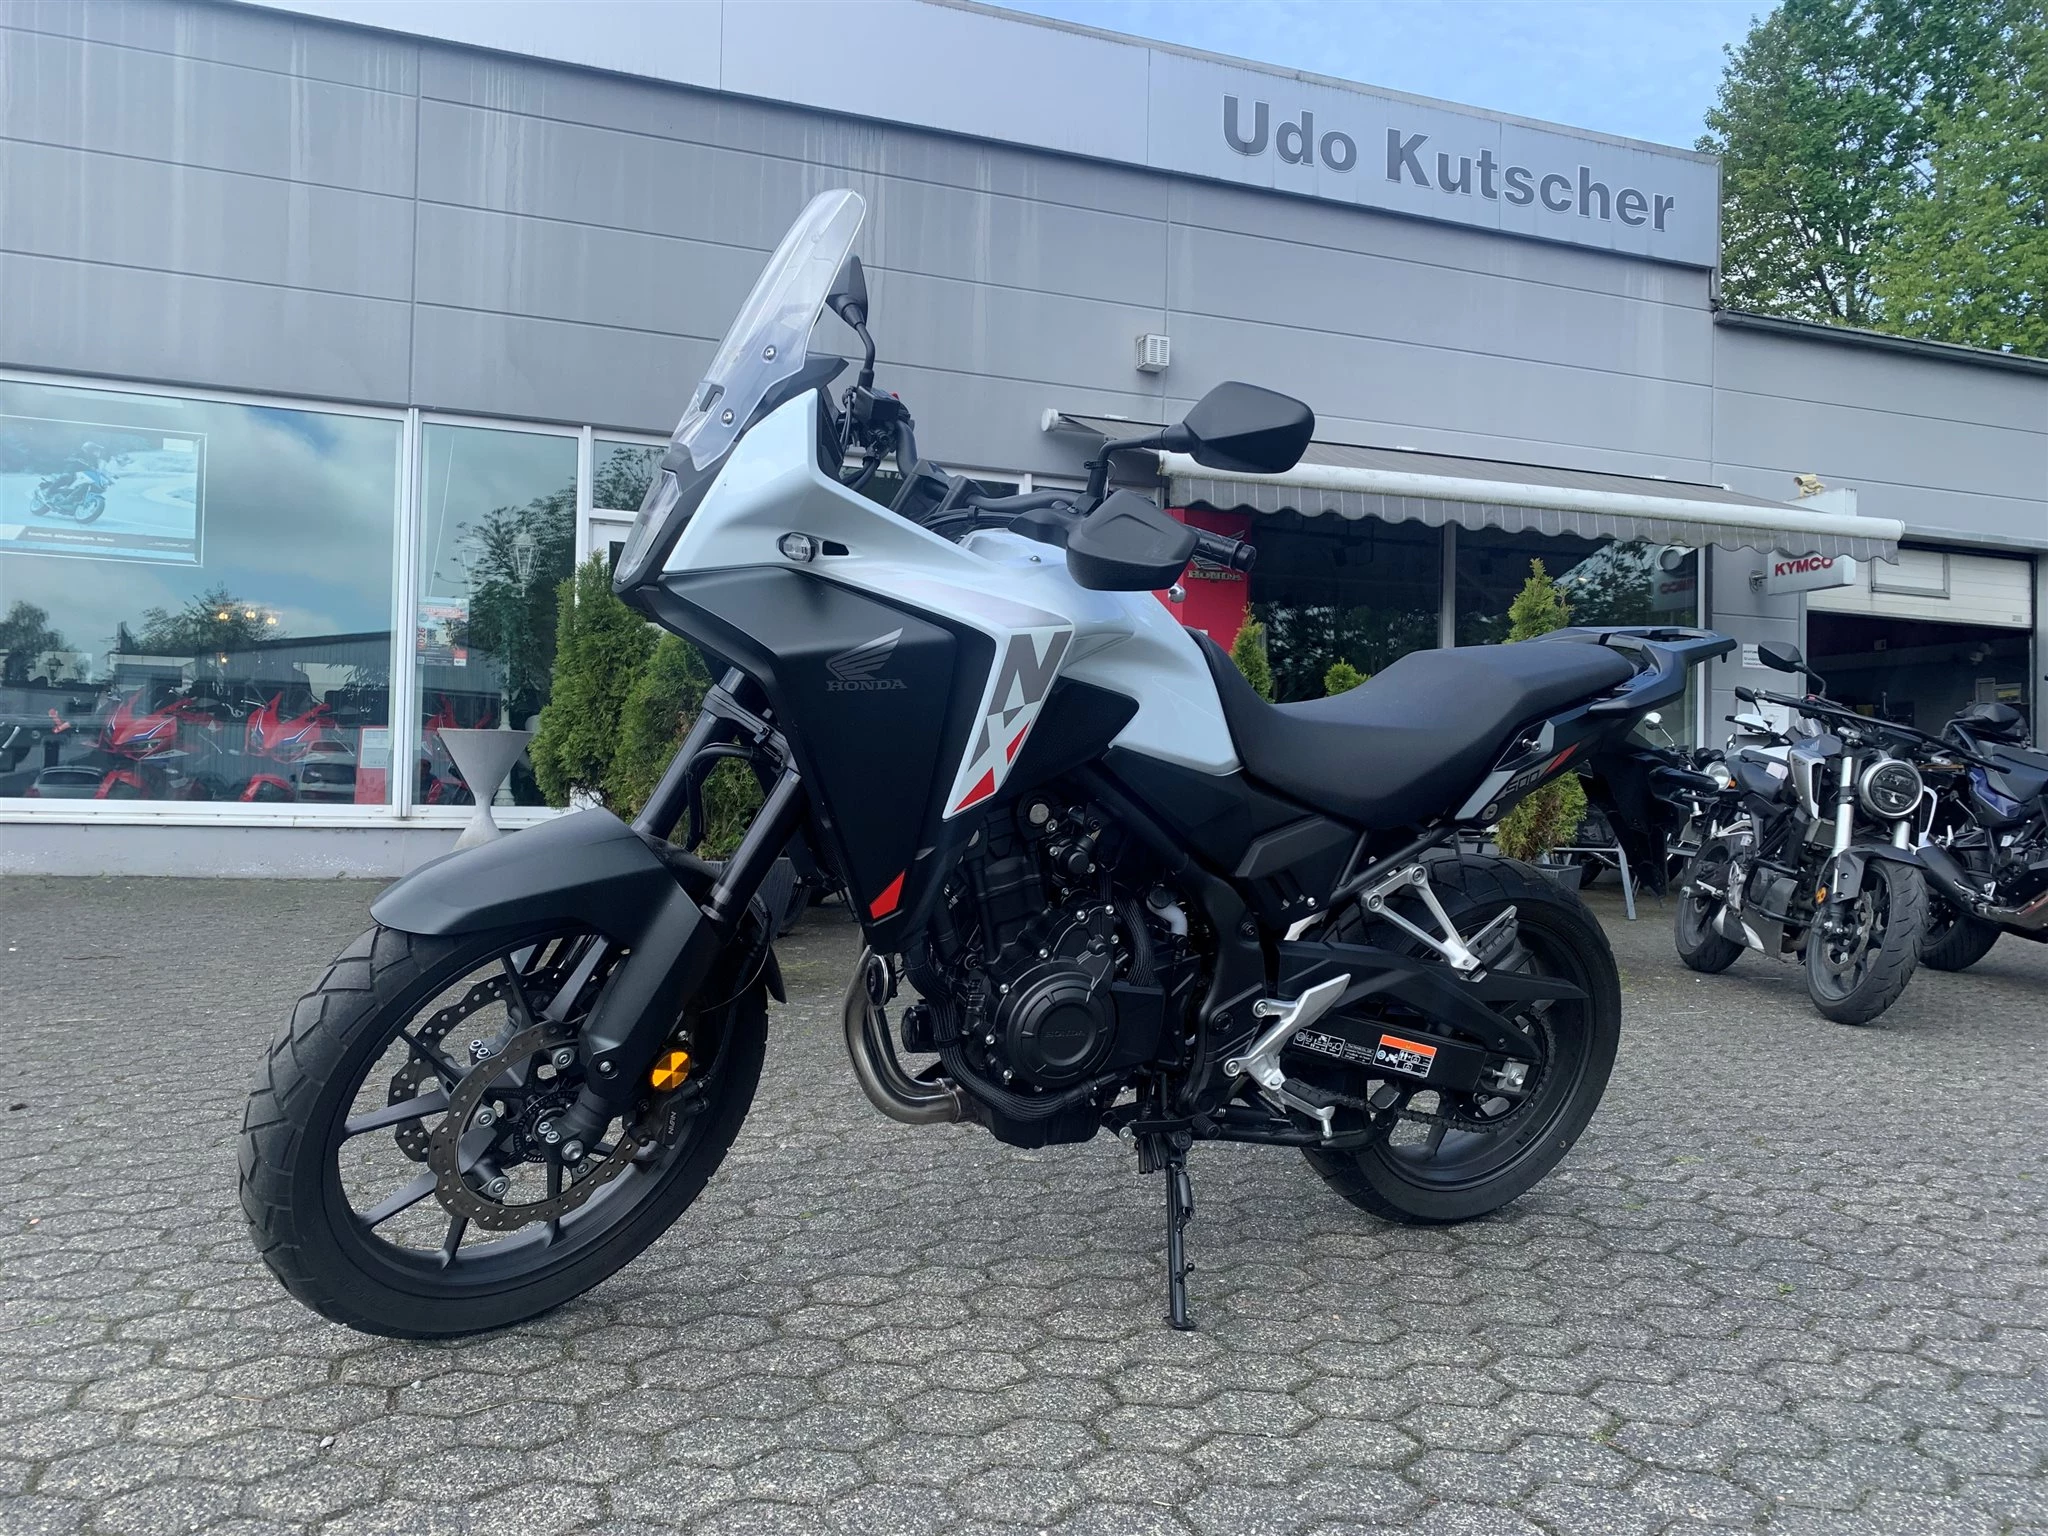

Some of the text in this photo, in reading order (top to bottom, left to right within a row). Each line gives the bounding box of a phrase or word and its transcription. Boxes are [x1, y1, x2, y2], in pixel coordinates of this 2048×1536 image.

[1222, 94, 1676, 233] Udo Kutscher
[1187, 570, 1243, 580] HONDA
[1774, 557, 1834, 577] KYMCO
[826, 679, 908, 691] HONDA
